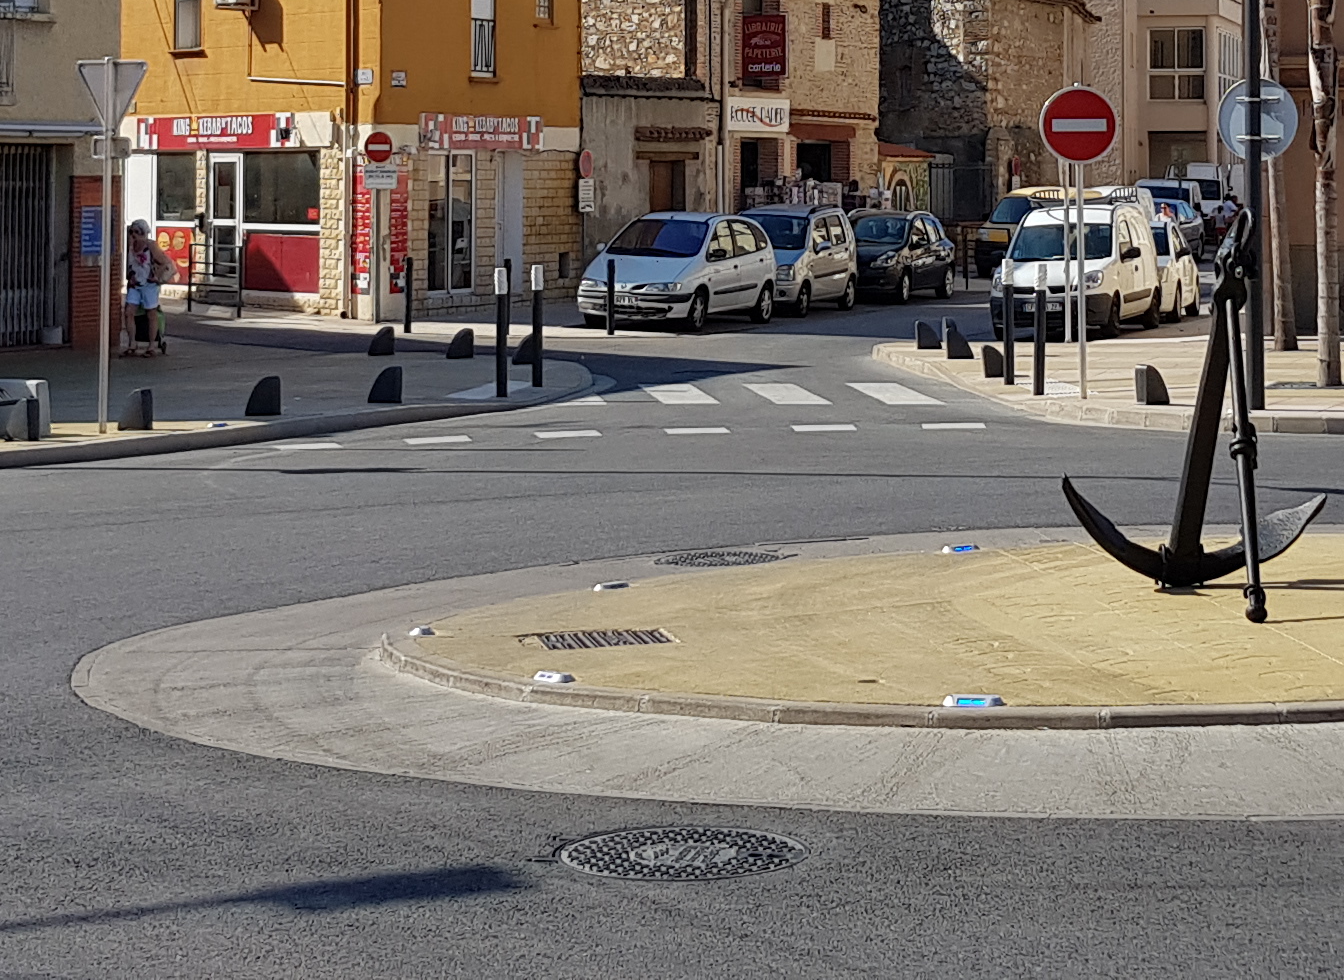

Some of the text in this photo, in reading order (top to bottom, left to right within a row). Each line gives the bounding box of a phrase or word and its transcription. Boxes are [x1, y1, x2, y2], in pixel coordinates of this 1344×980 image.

[744, 22, 783, 34] LIBRAIRIE
[744, 46, 784, 58] PAPETERIE
[173, 118, 190, 135] KING
